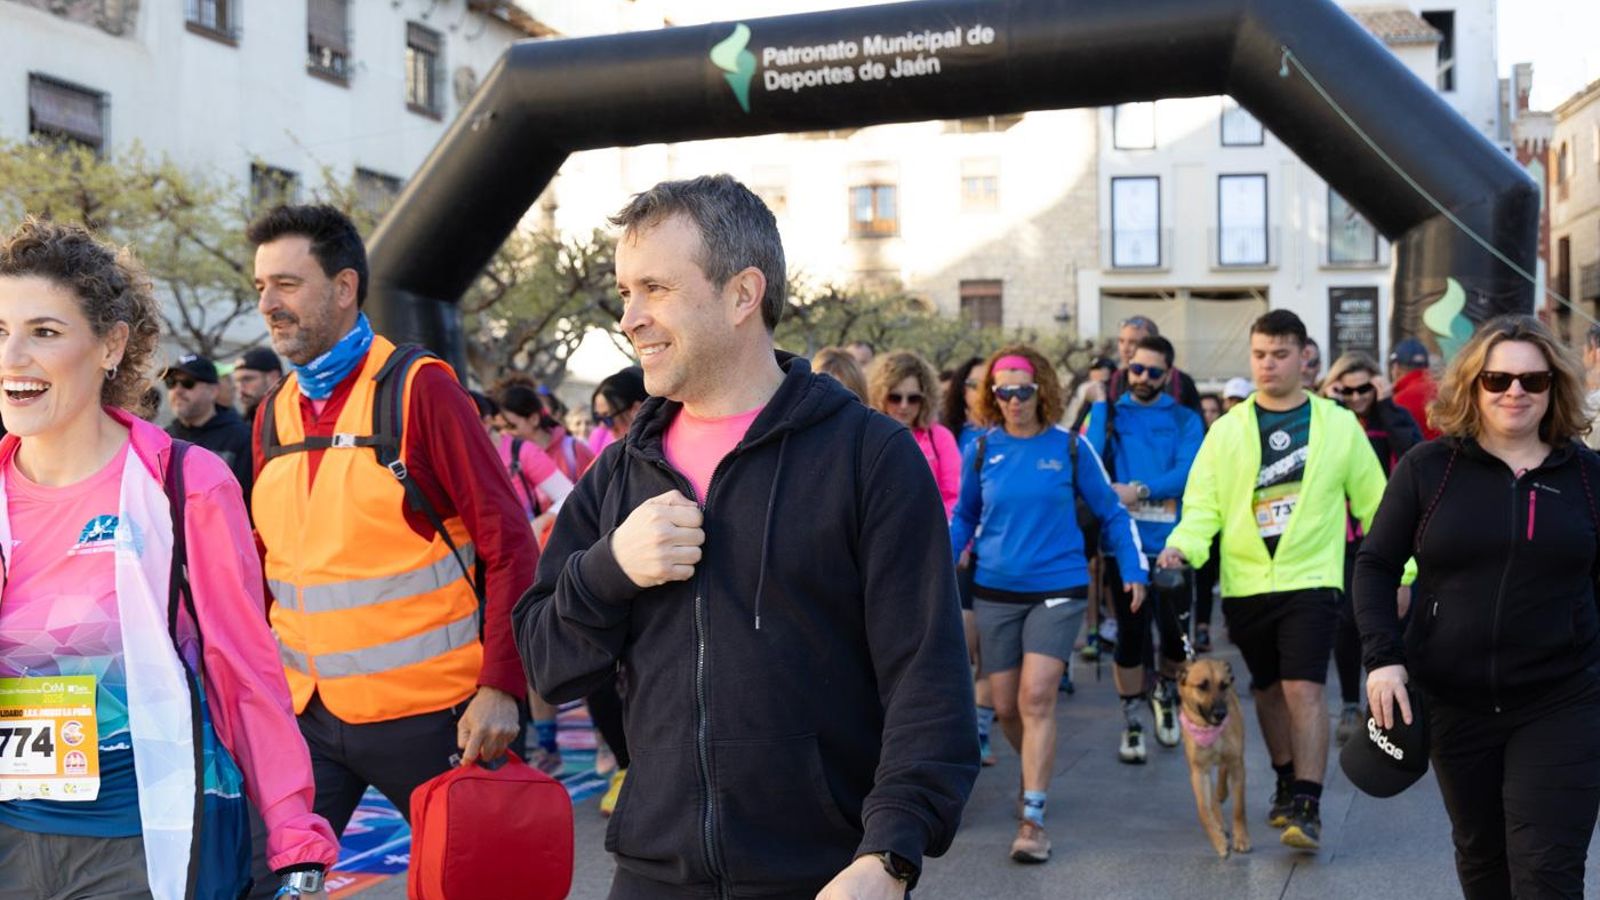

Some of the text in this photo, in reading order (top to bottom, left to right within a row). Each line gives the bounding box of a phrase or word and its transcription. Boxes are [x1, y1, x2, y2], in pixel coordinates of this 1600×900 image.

[763, 24, 995, 66] Patronato Municipal de
[764, 54, 940, 92] Deportes de Jaén
[1272, 502, 1296, 516] 73
[0, 727, 54, 757] 774
[1367, 717, 1404, 760] adidas
